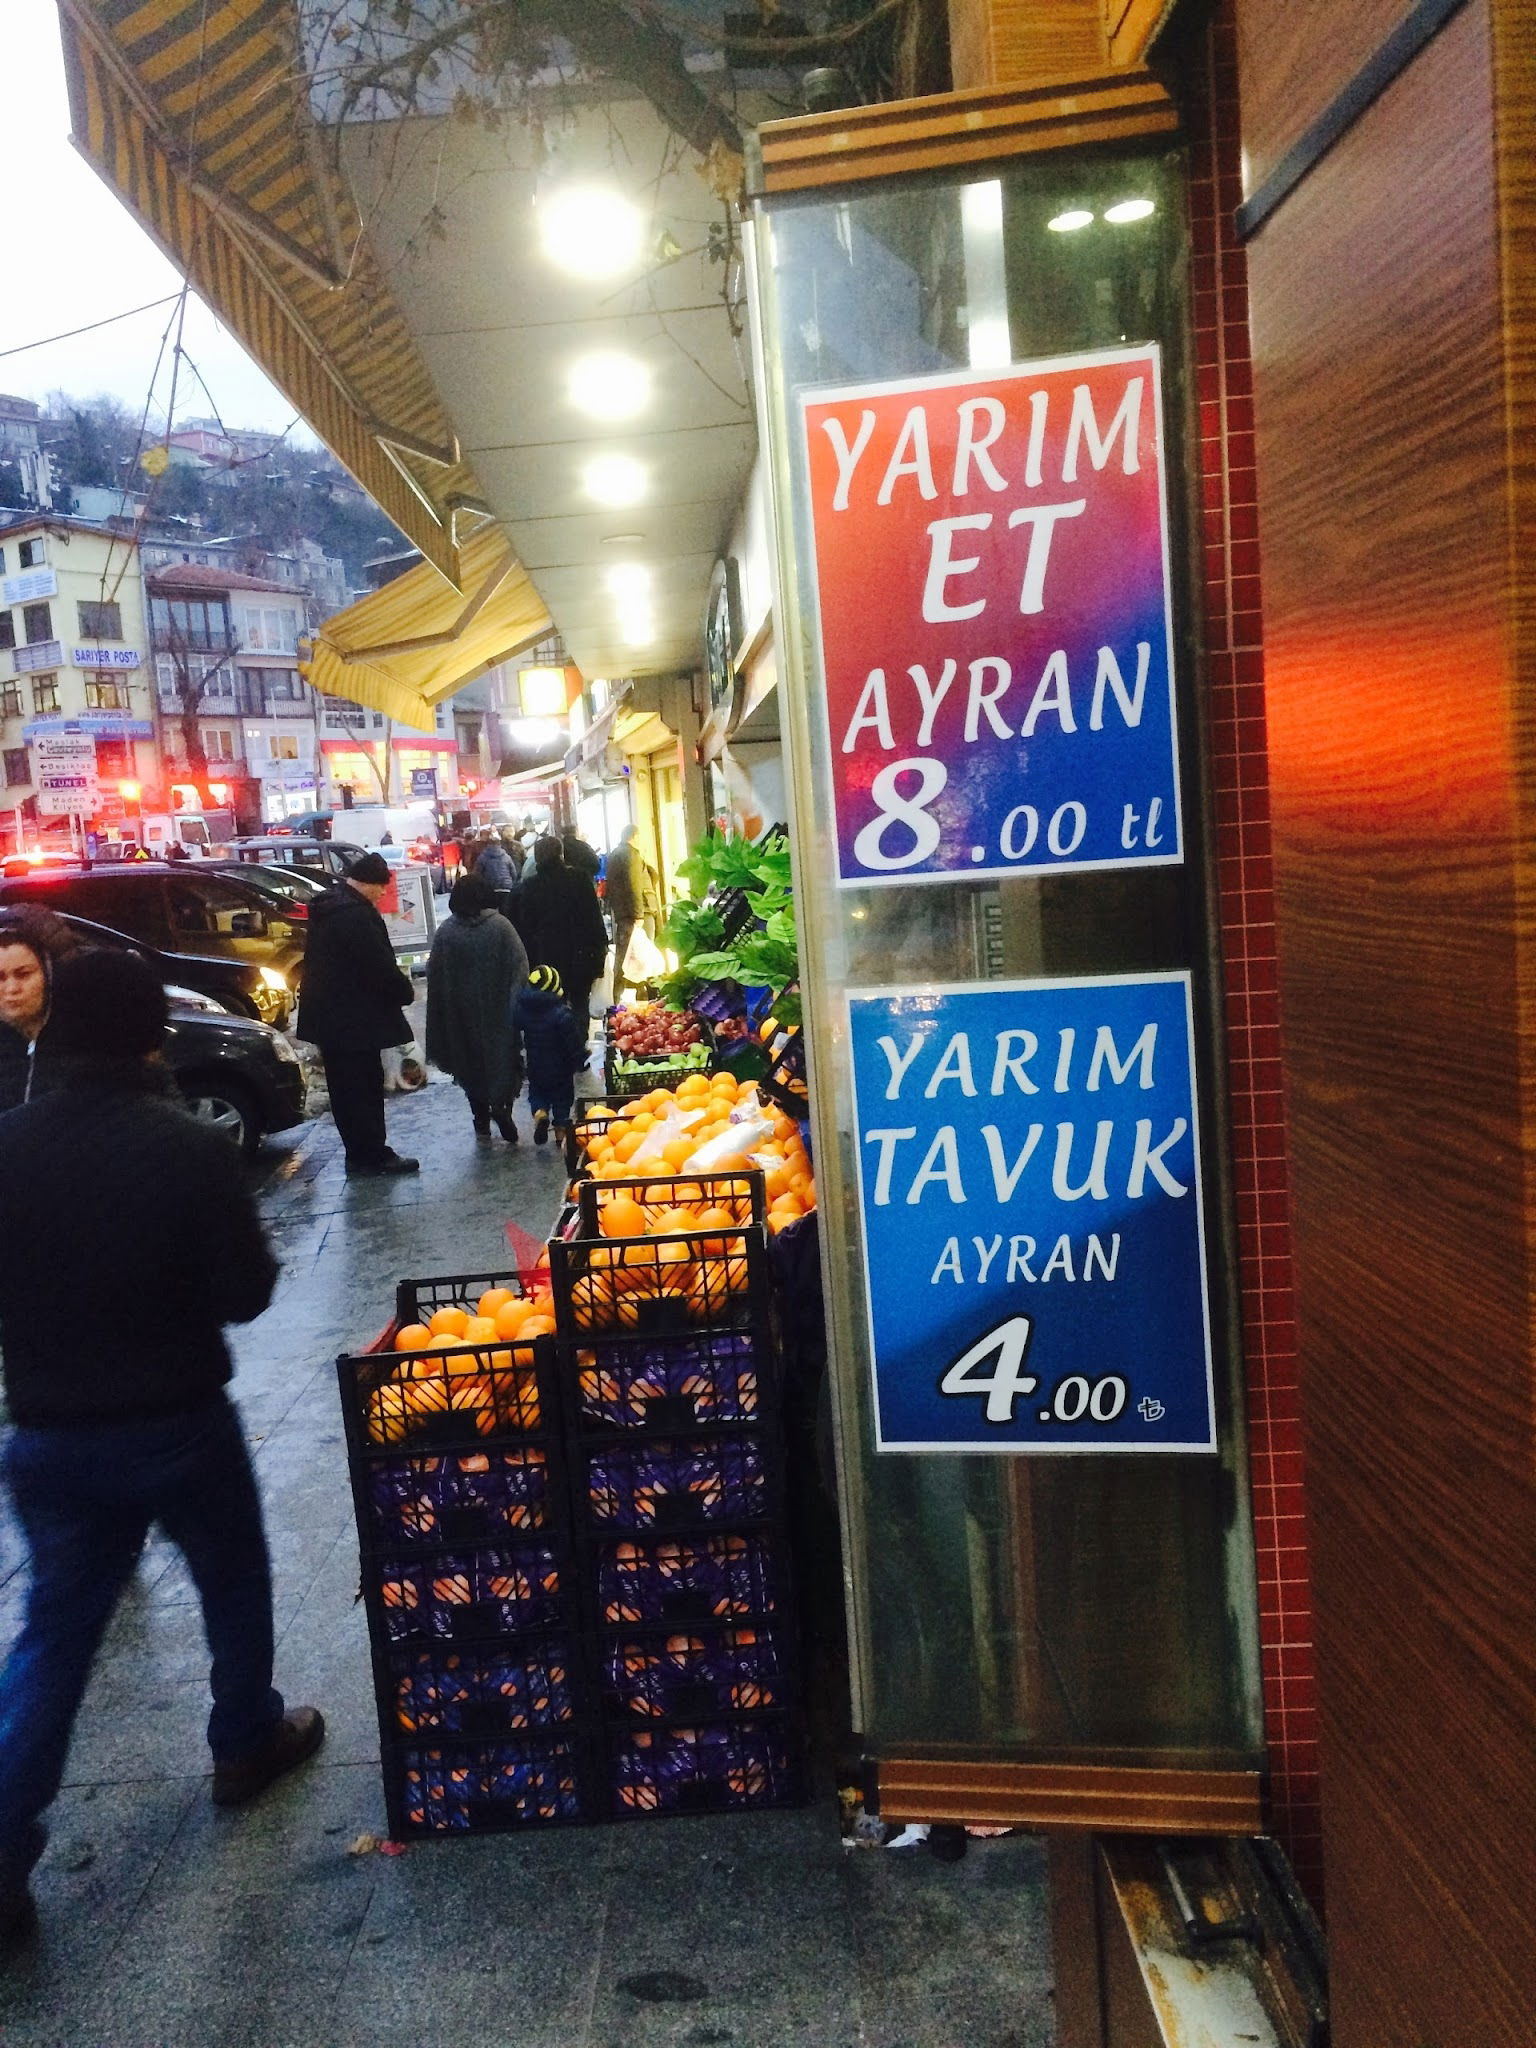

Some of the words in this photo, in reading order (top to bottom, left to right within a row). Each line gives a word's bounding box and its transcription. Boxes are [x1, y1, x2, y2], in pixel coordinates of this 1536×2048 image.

[821, 376, 1144, 511] YARIM
[922, 498, 1086, 624] ET
[75, 649, 110, 662] SARIYER
[841, 641, 1151, 754] AYRAN
[853, 757, 1087, 871] 8.00
[1121, 797, 1164, 849] tl
[876, 1023, 1158, 1100] YARIM
[865, 1117, 1188, 1206] TAVUK
[930, 1233, 1120, 1284] AYRAN
[941, 1317, 1126, 1421] 4.00
